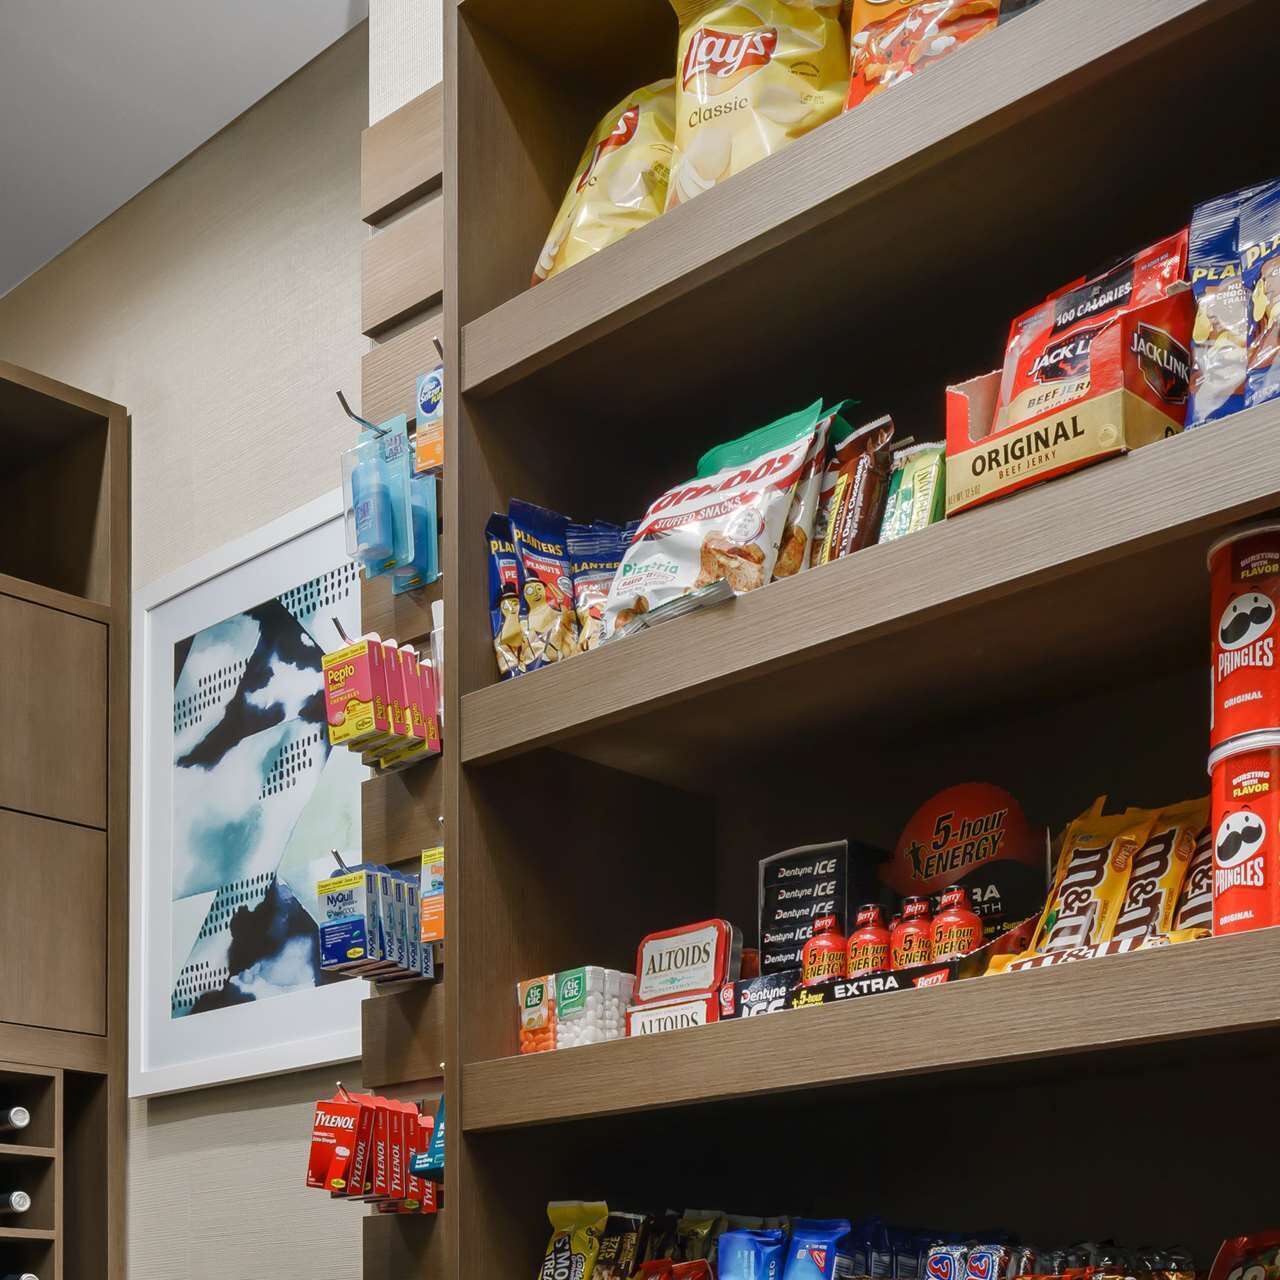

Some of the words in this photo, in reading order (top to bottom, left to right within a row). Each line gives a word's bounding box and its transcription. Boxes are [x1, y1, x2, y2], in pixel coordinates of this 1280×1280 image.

[688, 96, 749, 128] Classic
[1056, 310, 1075, 326] 100
[1076, 283, 1132, 317] CALORIES
[1028, 343, 1073, 375] JACK
[971, 416, 1085, 477] ORIGINAL
[998, 462, 1022, 479] BEEF
[1027, 450, 1057, 470] JERKY
[654, 512, 696, 529] STUFFED
[699, 494, 742, 520] SNACKS
[843, 512, 853, 536] Dark
[514, 529, 563, 556] PLANTERS
[527, 561, 561, 575] PEANUTS
[1218, 638, 1273, 682] PRINGLES
[328, 664, 355, 683] Pepto
[1224, 691, 1263, 708] ORIGINAL
[1233, 771, 1269, 785] BURSTING
[1233, 783, 1269, 798] FLAVOR
[932, 809, 1008, 850] 5-hour
[922, 829, 1003, 880] ENERGY
[778, 866, 813, 879] Dentyne
[813, 859, 837, 876] ICE
[1216, 857, 1264, 896] PRINGLES
[327, 890, 353, 906] NyQuil
[815, 917, 832, 929] Berry
[646, 942, 711, 976] ALTOIDS
[530, 985, 542, 997] tic
[564, 985, 579, 998] tac
[567, 978, 580, 990] tic
[740, 985, 786, 1003] Dentyne
[834, 976, 899, 999] EXTRA
[527, 994, 542, 1005] tac
[315, 1111, 355, 1129] TYLENOL
[351, 1140, 366, 1188] TYLENOL
[927, 1255, 952, 1280] 3
[969, 1255, 989, 1280] 3
